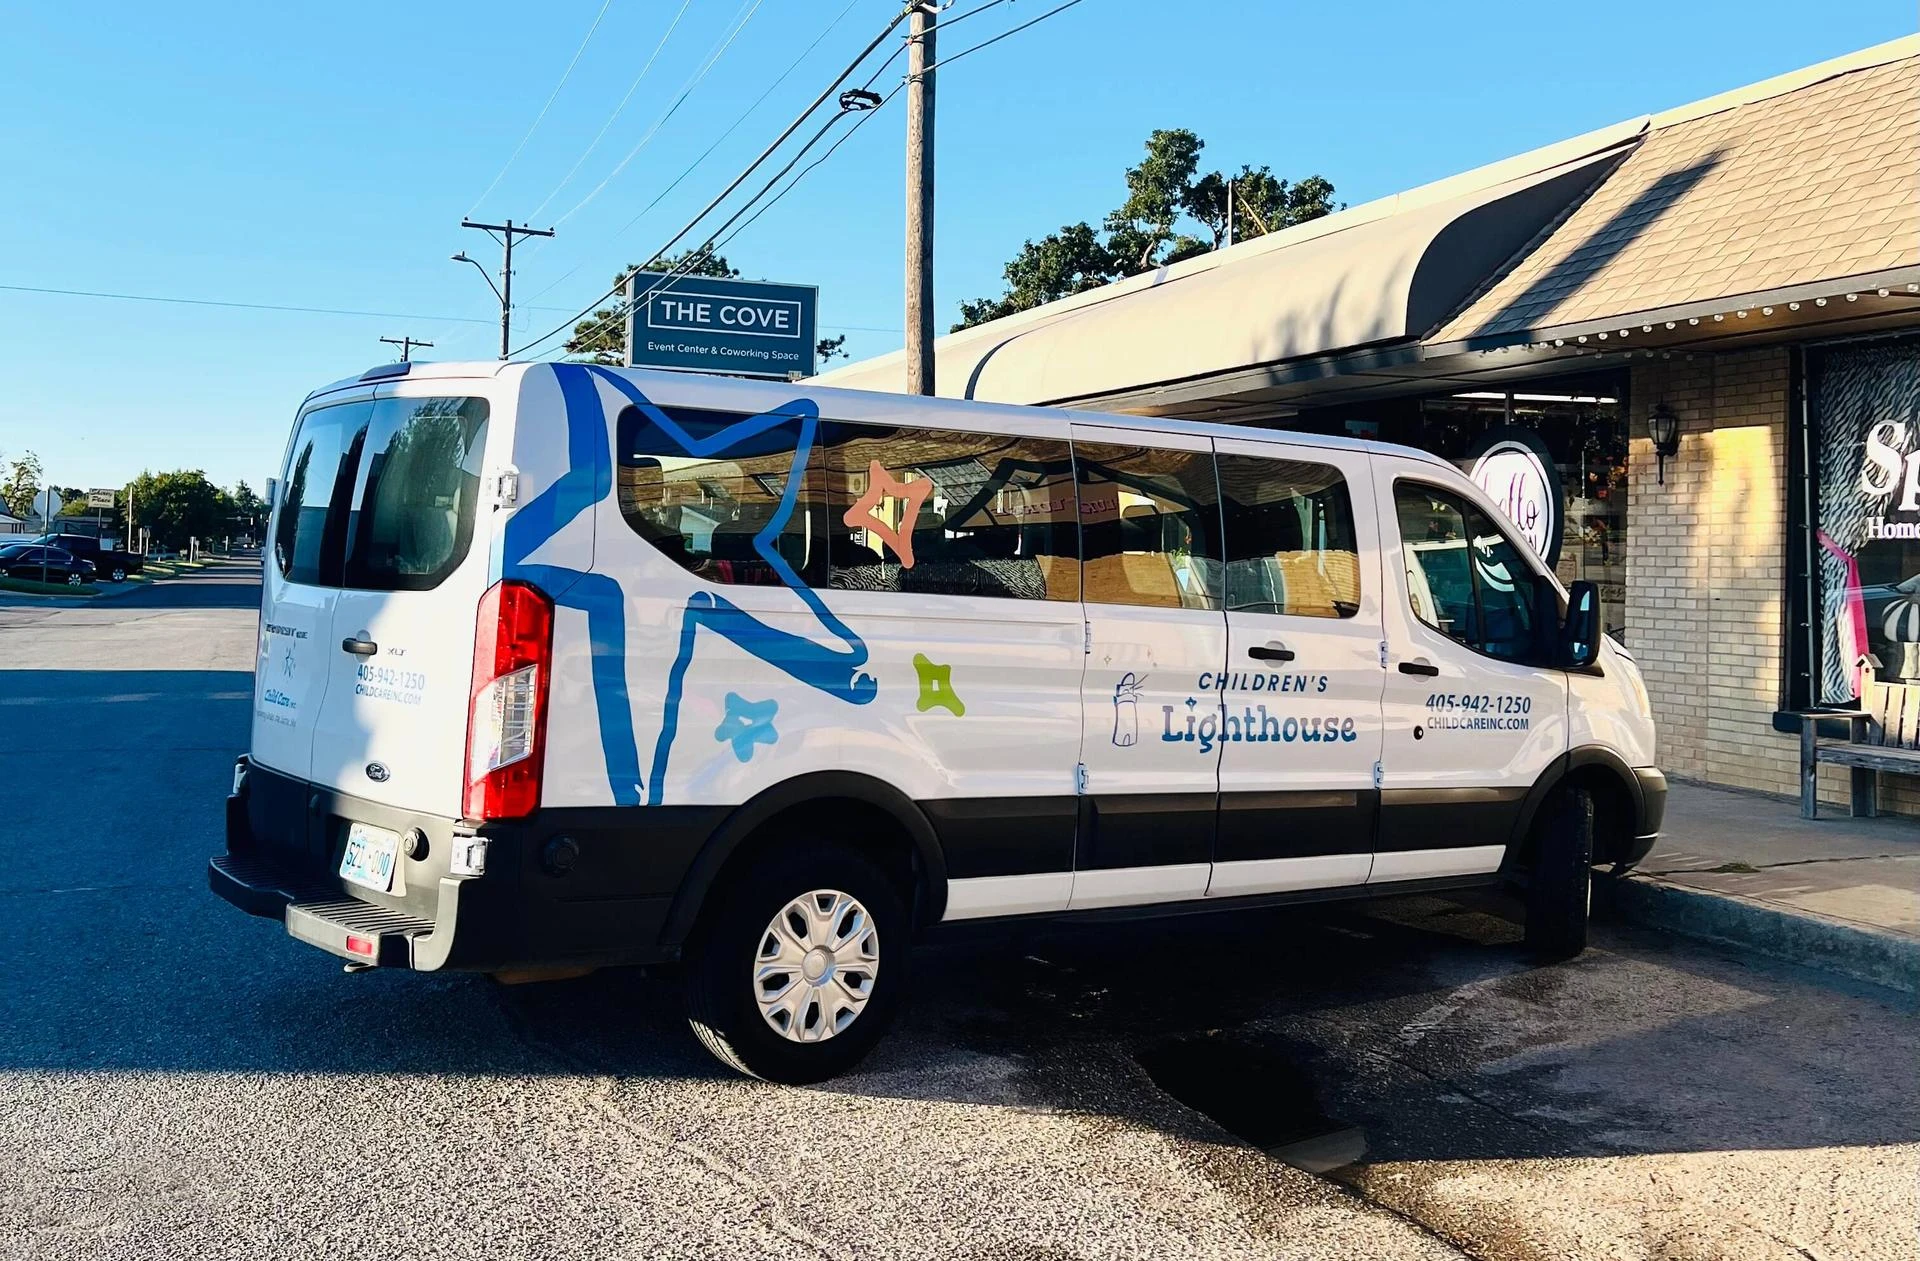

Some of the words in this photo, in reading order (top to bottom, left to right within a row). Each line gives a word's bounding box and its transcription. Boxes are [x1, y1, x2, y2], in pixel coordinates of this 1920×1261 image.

[661, 301, 711, 323] THE
[720, 305, 789, 329] COVE
[648, 342, 675, 353] Event
[678, 343, 708, 354] Center
[711, 346, 718, 354] &
[720, 347, 769, 360] Coworking
[772, 350, 799, 361] Space
[357, 664, 425, 690] 405-942-1250
[1198, 671, 1329, 693] CHILDREN'S
[356, 683, 422, 705] CHILDCAREINC.COM
[1425, 693, 1531, 715] 405-942-1250
[1161, 698, 1357, 753] Lighthouse
[1426, 717, 1530, 731] CHILDCAREINC.COM
